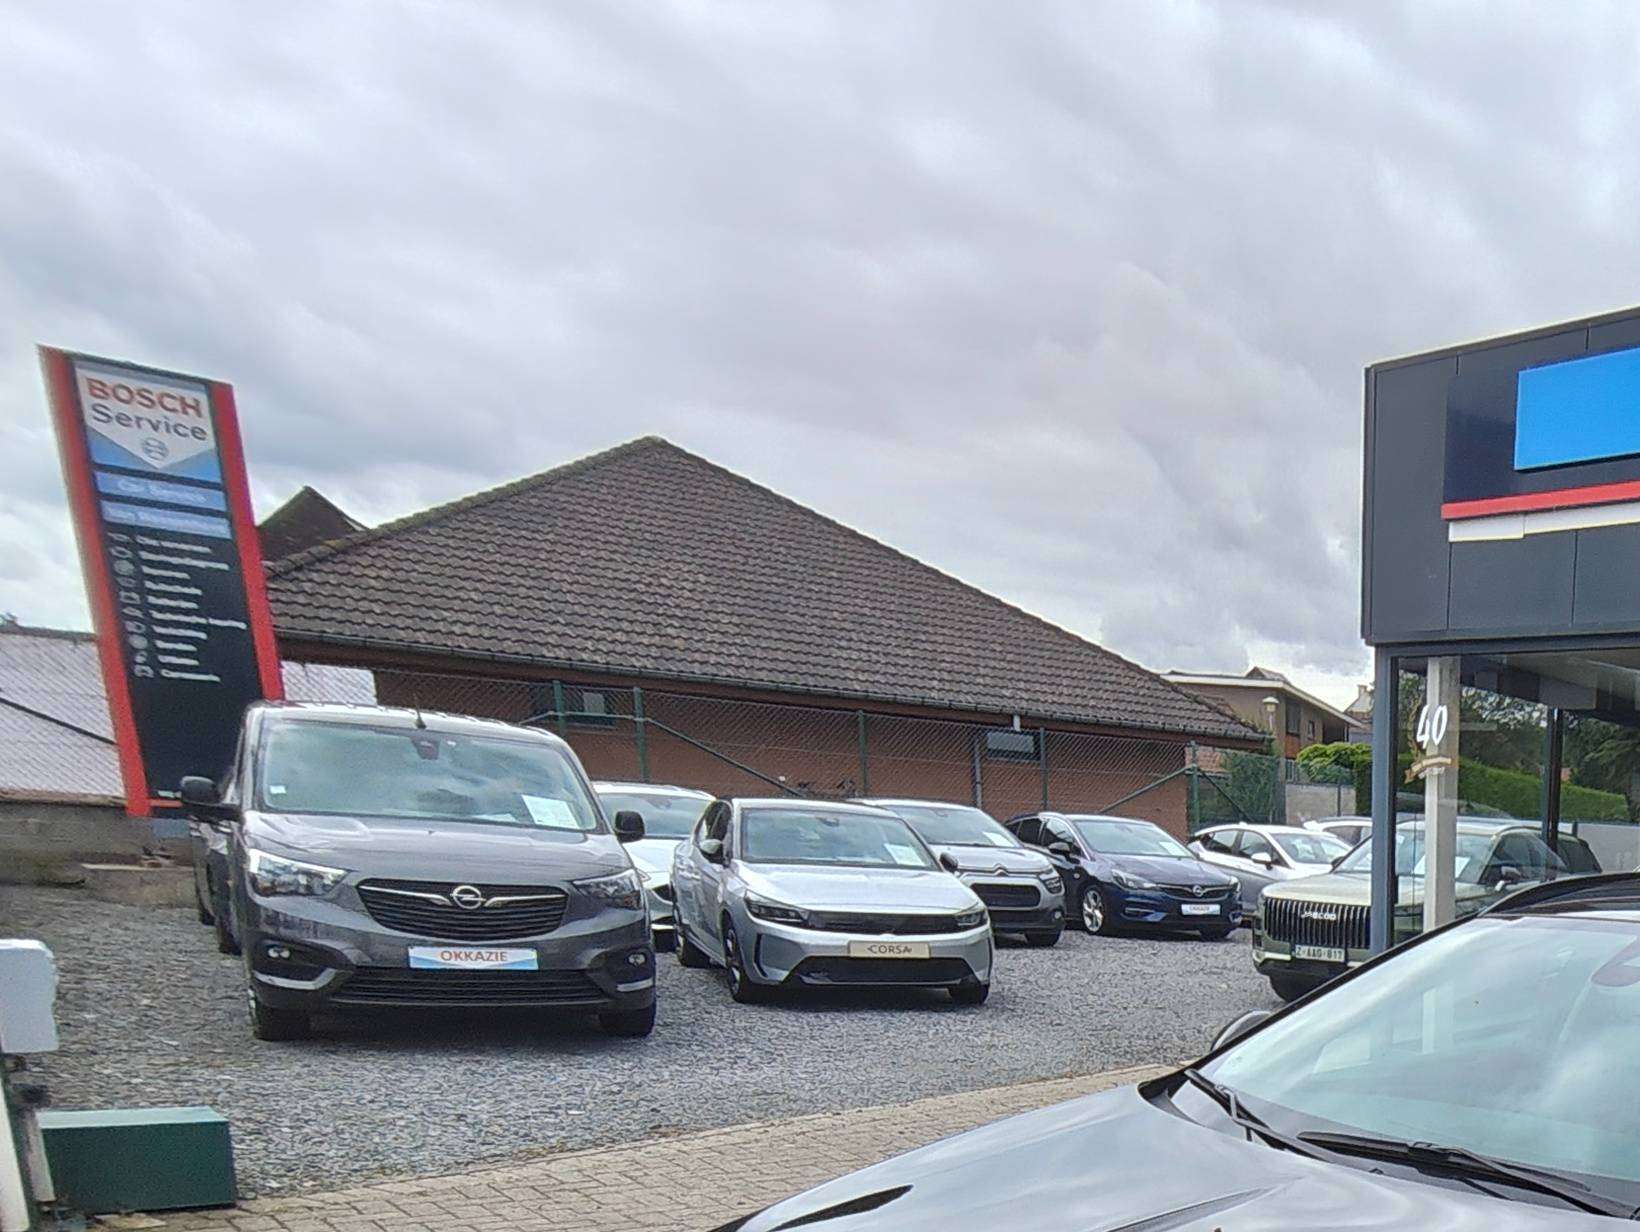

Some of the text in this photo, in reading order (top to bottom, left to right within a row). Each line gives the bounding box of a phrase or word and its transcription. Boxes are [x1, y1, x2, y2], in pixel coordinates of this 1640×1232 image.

[86, 377, 204, 418] BOSCH
[91, 403, 208, 441] Service
[1416, 704, 1448, 750] 40
[440, 950, 508, 961] OKKAZIE
[868, 944, 911, 955] CORSA
